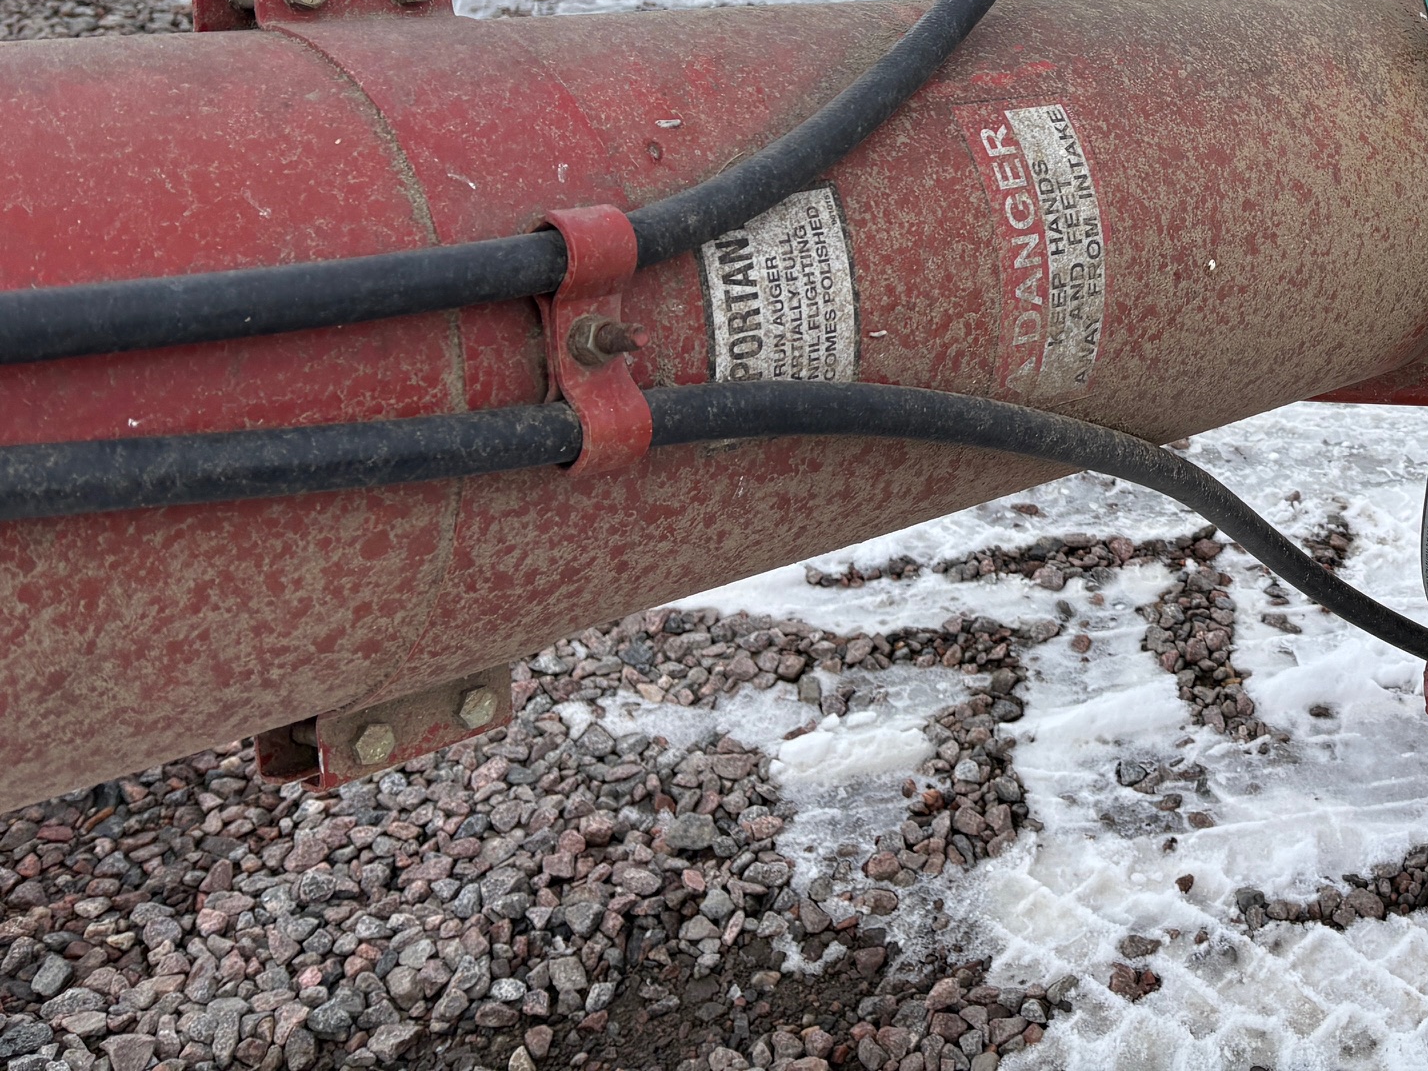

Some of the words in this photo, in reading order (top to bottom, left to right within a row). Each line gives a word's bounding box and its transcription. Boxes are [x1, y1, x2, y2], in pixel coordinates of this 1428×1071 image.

[1046, 109, 1093, 200] INTAKE
[981, 124, 1043, 347] DANGER
[1031, 159, 1066, 256] HANDS
[1056, 180, 1083, 246] FEET
[765, 255, 785, 327] AUGER
[779, 232, 799, 283] FULL
[794, 225, 820, 332] FLIGHTING
[806, 205, 834, 304] POLISHED
[1069, 262, 1085, 320] AND
[1082, 215, 1102, 297] FROM
[714, 237, 763, 380] PORTAN
[787, 288, 804, 380] ARTIALLY
[824, 308, 837, 380] COMES
[1047, 272, 1067, 347] KEEP
[773, 332, 787, 378] RUN
[807, 334, 821, 380] NTIL
